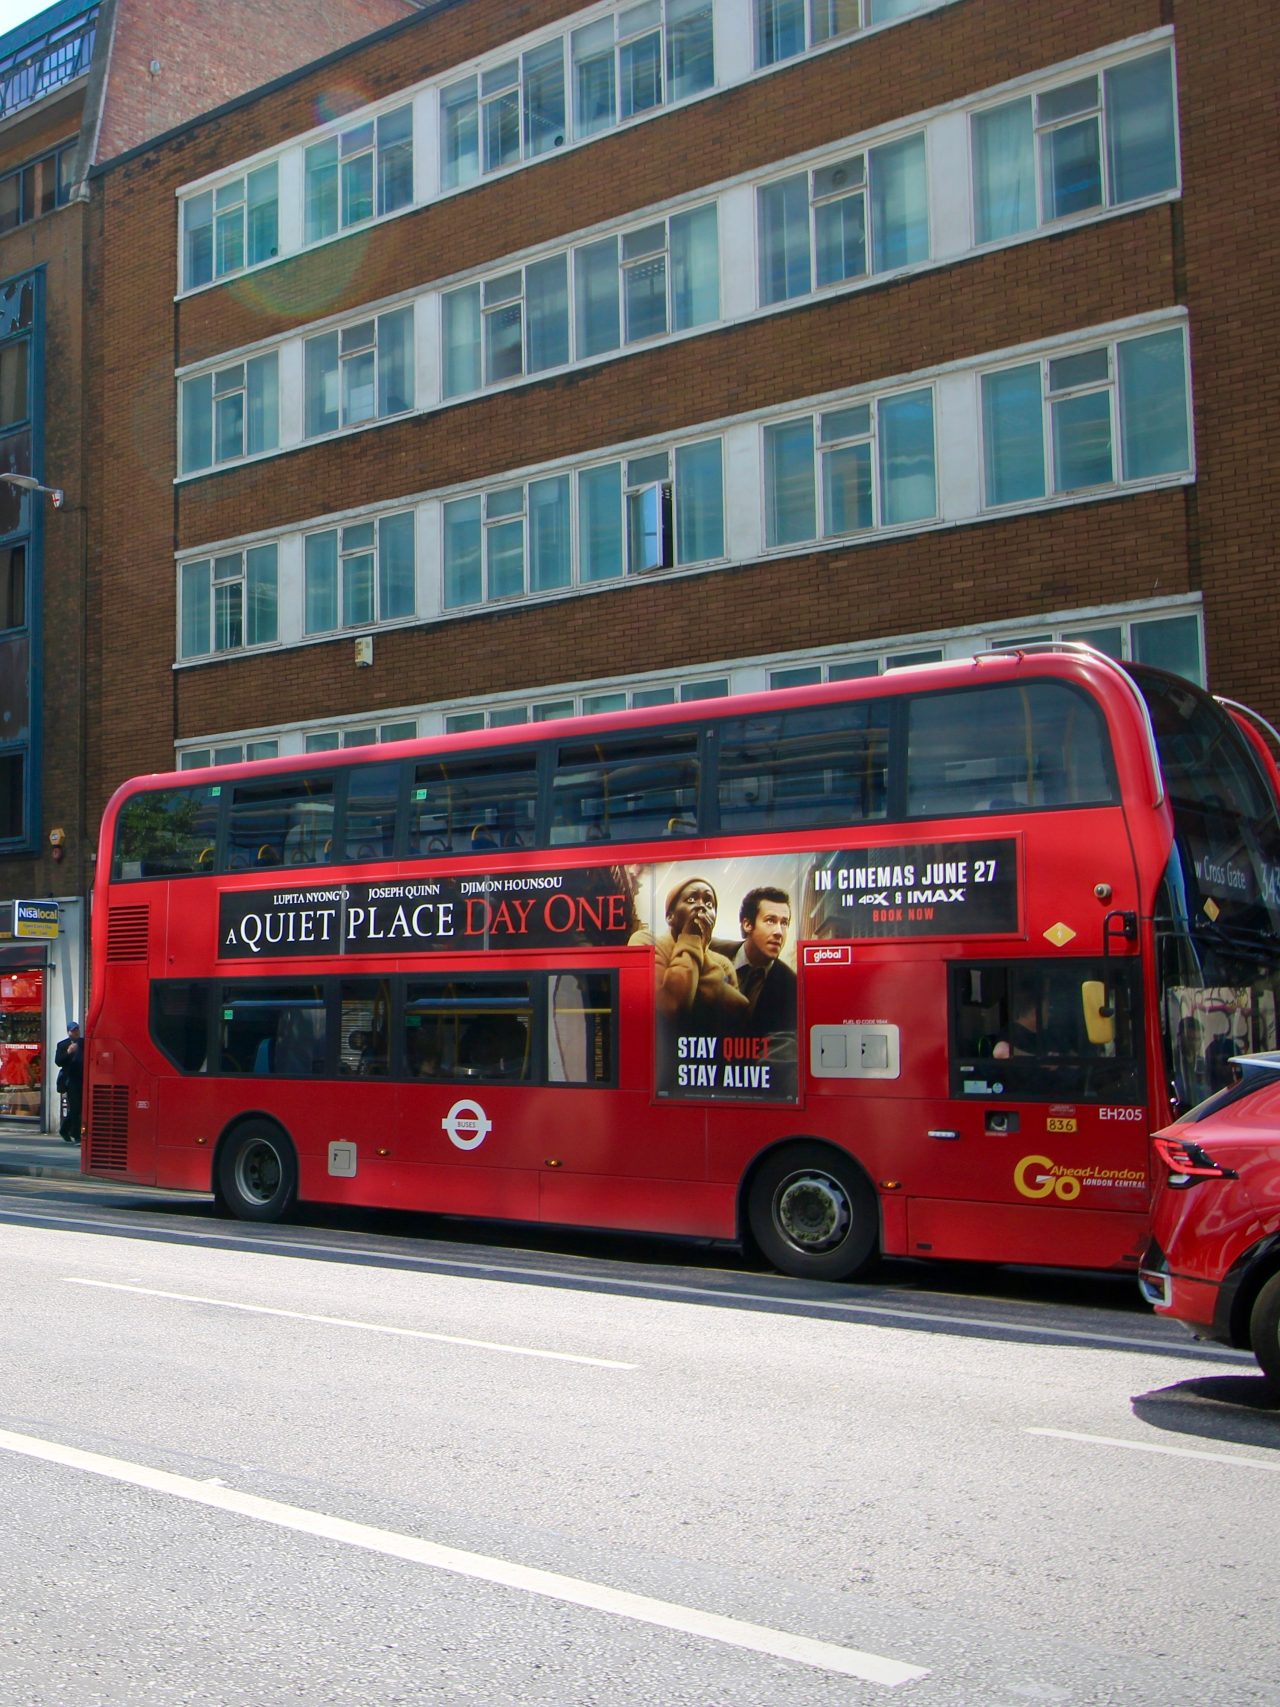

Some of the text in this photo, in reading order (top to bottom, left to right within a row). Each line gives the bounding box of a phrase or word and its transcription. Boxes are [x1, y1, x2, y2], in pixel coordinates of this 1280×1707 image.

[815, 860, 996, 891] IN CINEMAS JUNE 27
[1204, 855, 1225, 885] Cross
[1227, 862, 1246, 889] Gate
[368, 884, 440, 902] JOSEPH QUINN
[460, 876, 563, 896] DJIMON HOUNSOU
[273, 890, 349, 905] LUPITA NYONG'O
[842, 894, 853, 907] IN
[858, 892, 889, 906] 4DX
[908, 889, 966, 904] IMAX
[226, 894, 627, 952] A QUIET PLACE DAY ONE
[872, 907, 934, 922] BOOK NOW
[814, 949, 841, 962] global
[678, 1037, 769, 1061] STAY QUIET
[678, 1064, 770, 1088] STAY ALIVE
[1099, 1108, 1143, 1121] EH205
[1049, 1119, 1074, 1131] 836
[1014, 1155, 1080, 1201] Go
[1083, 1178, 1145, 1188] LONDON CENTRAL
